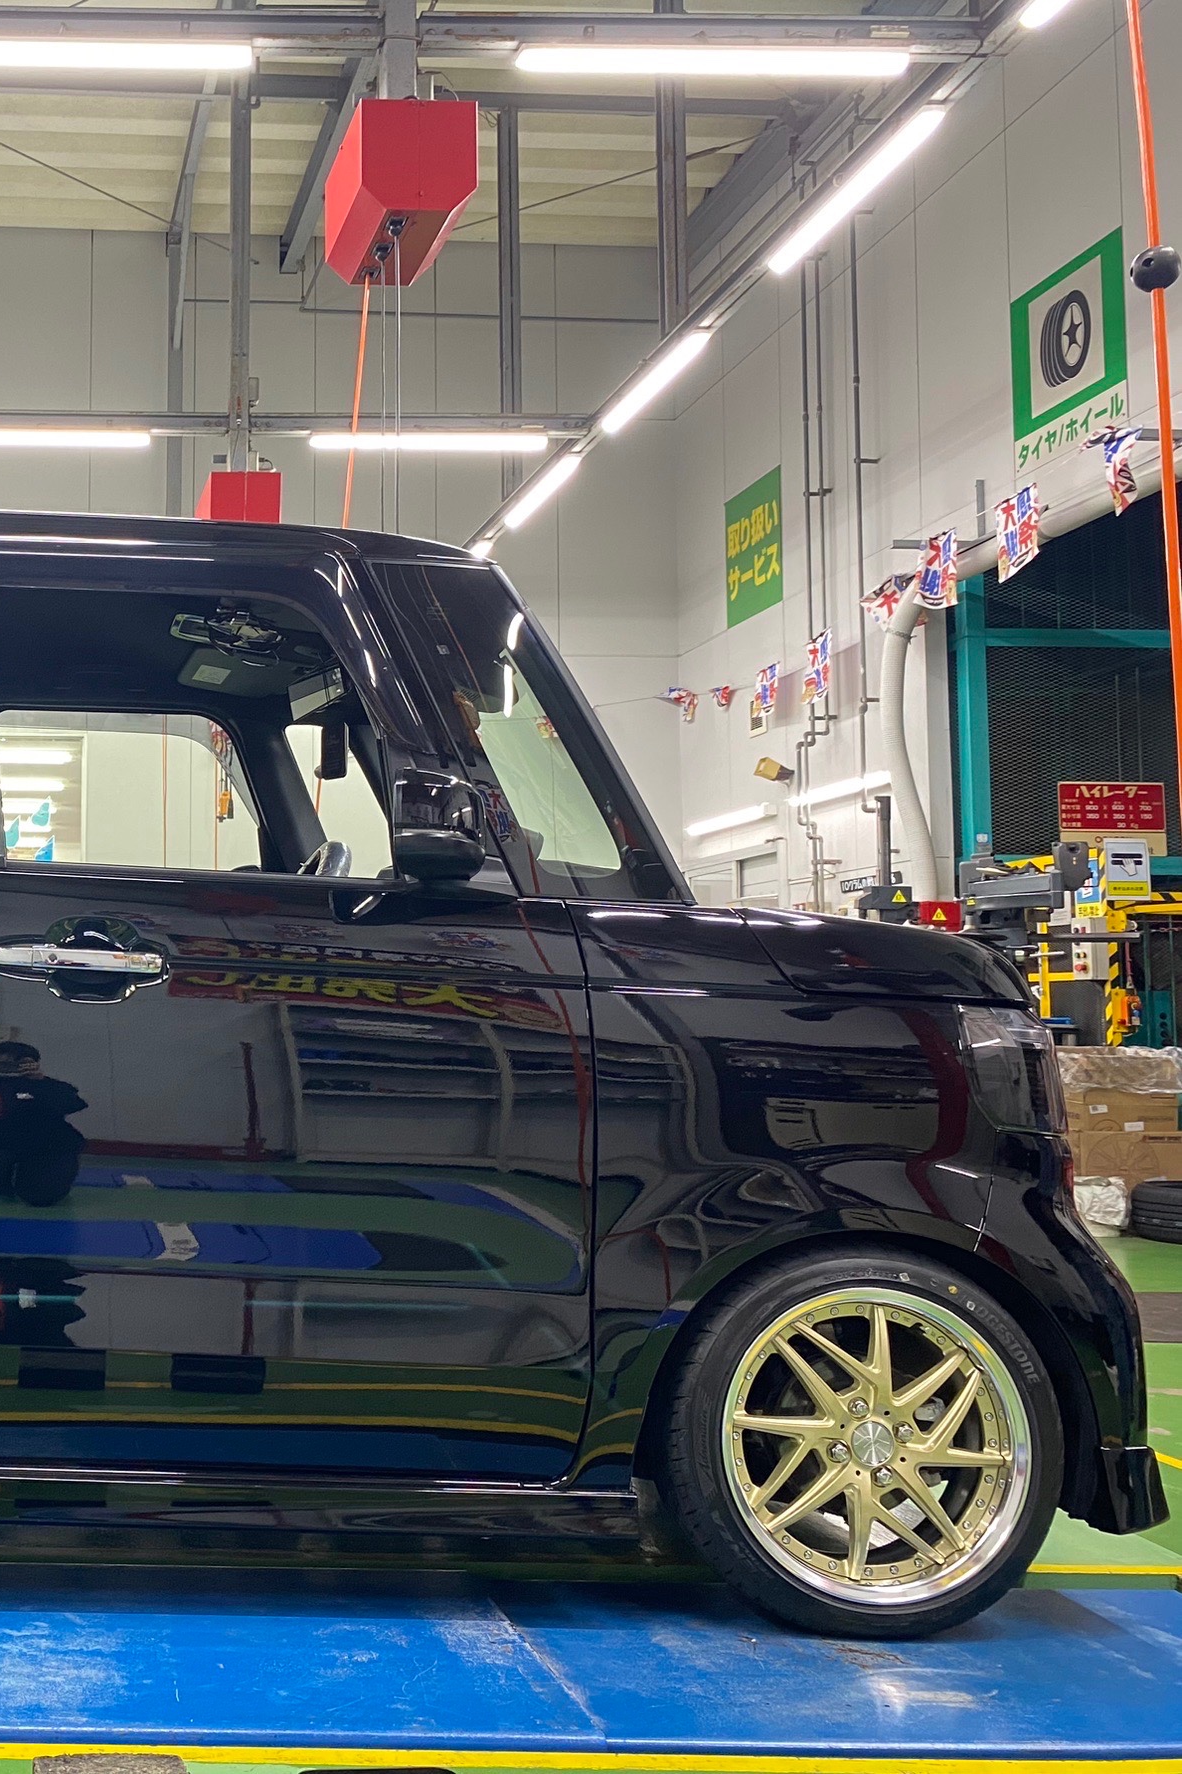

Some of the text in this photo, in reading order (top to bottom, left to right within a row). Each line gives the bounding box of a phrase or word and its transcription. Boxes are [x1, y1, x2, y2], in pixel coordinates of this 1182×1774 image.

[1018, 393, 1124, 468] タイヤ/ホイール
[728, 499, 779, 558] 取り扱い
[728, 543, 780, 601] サービス
[1075, 785, 1148, 798] ハイレーター
